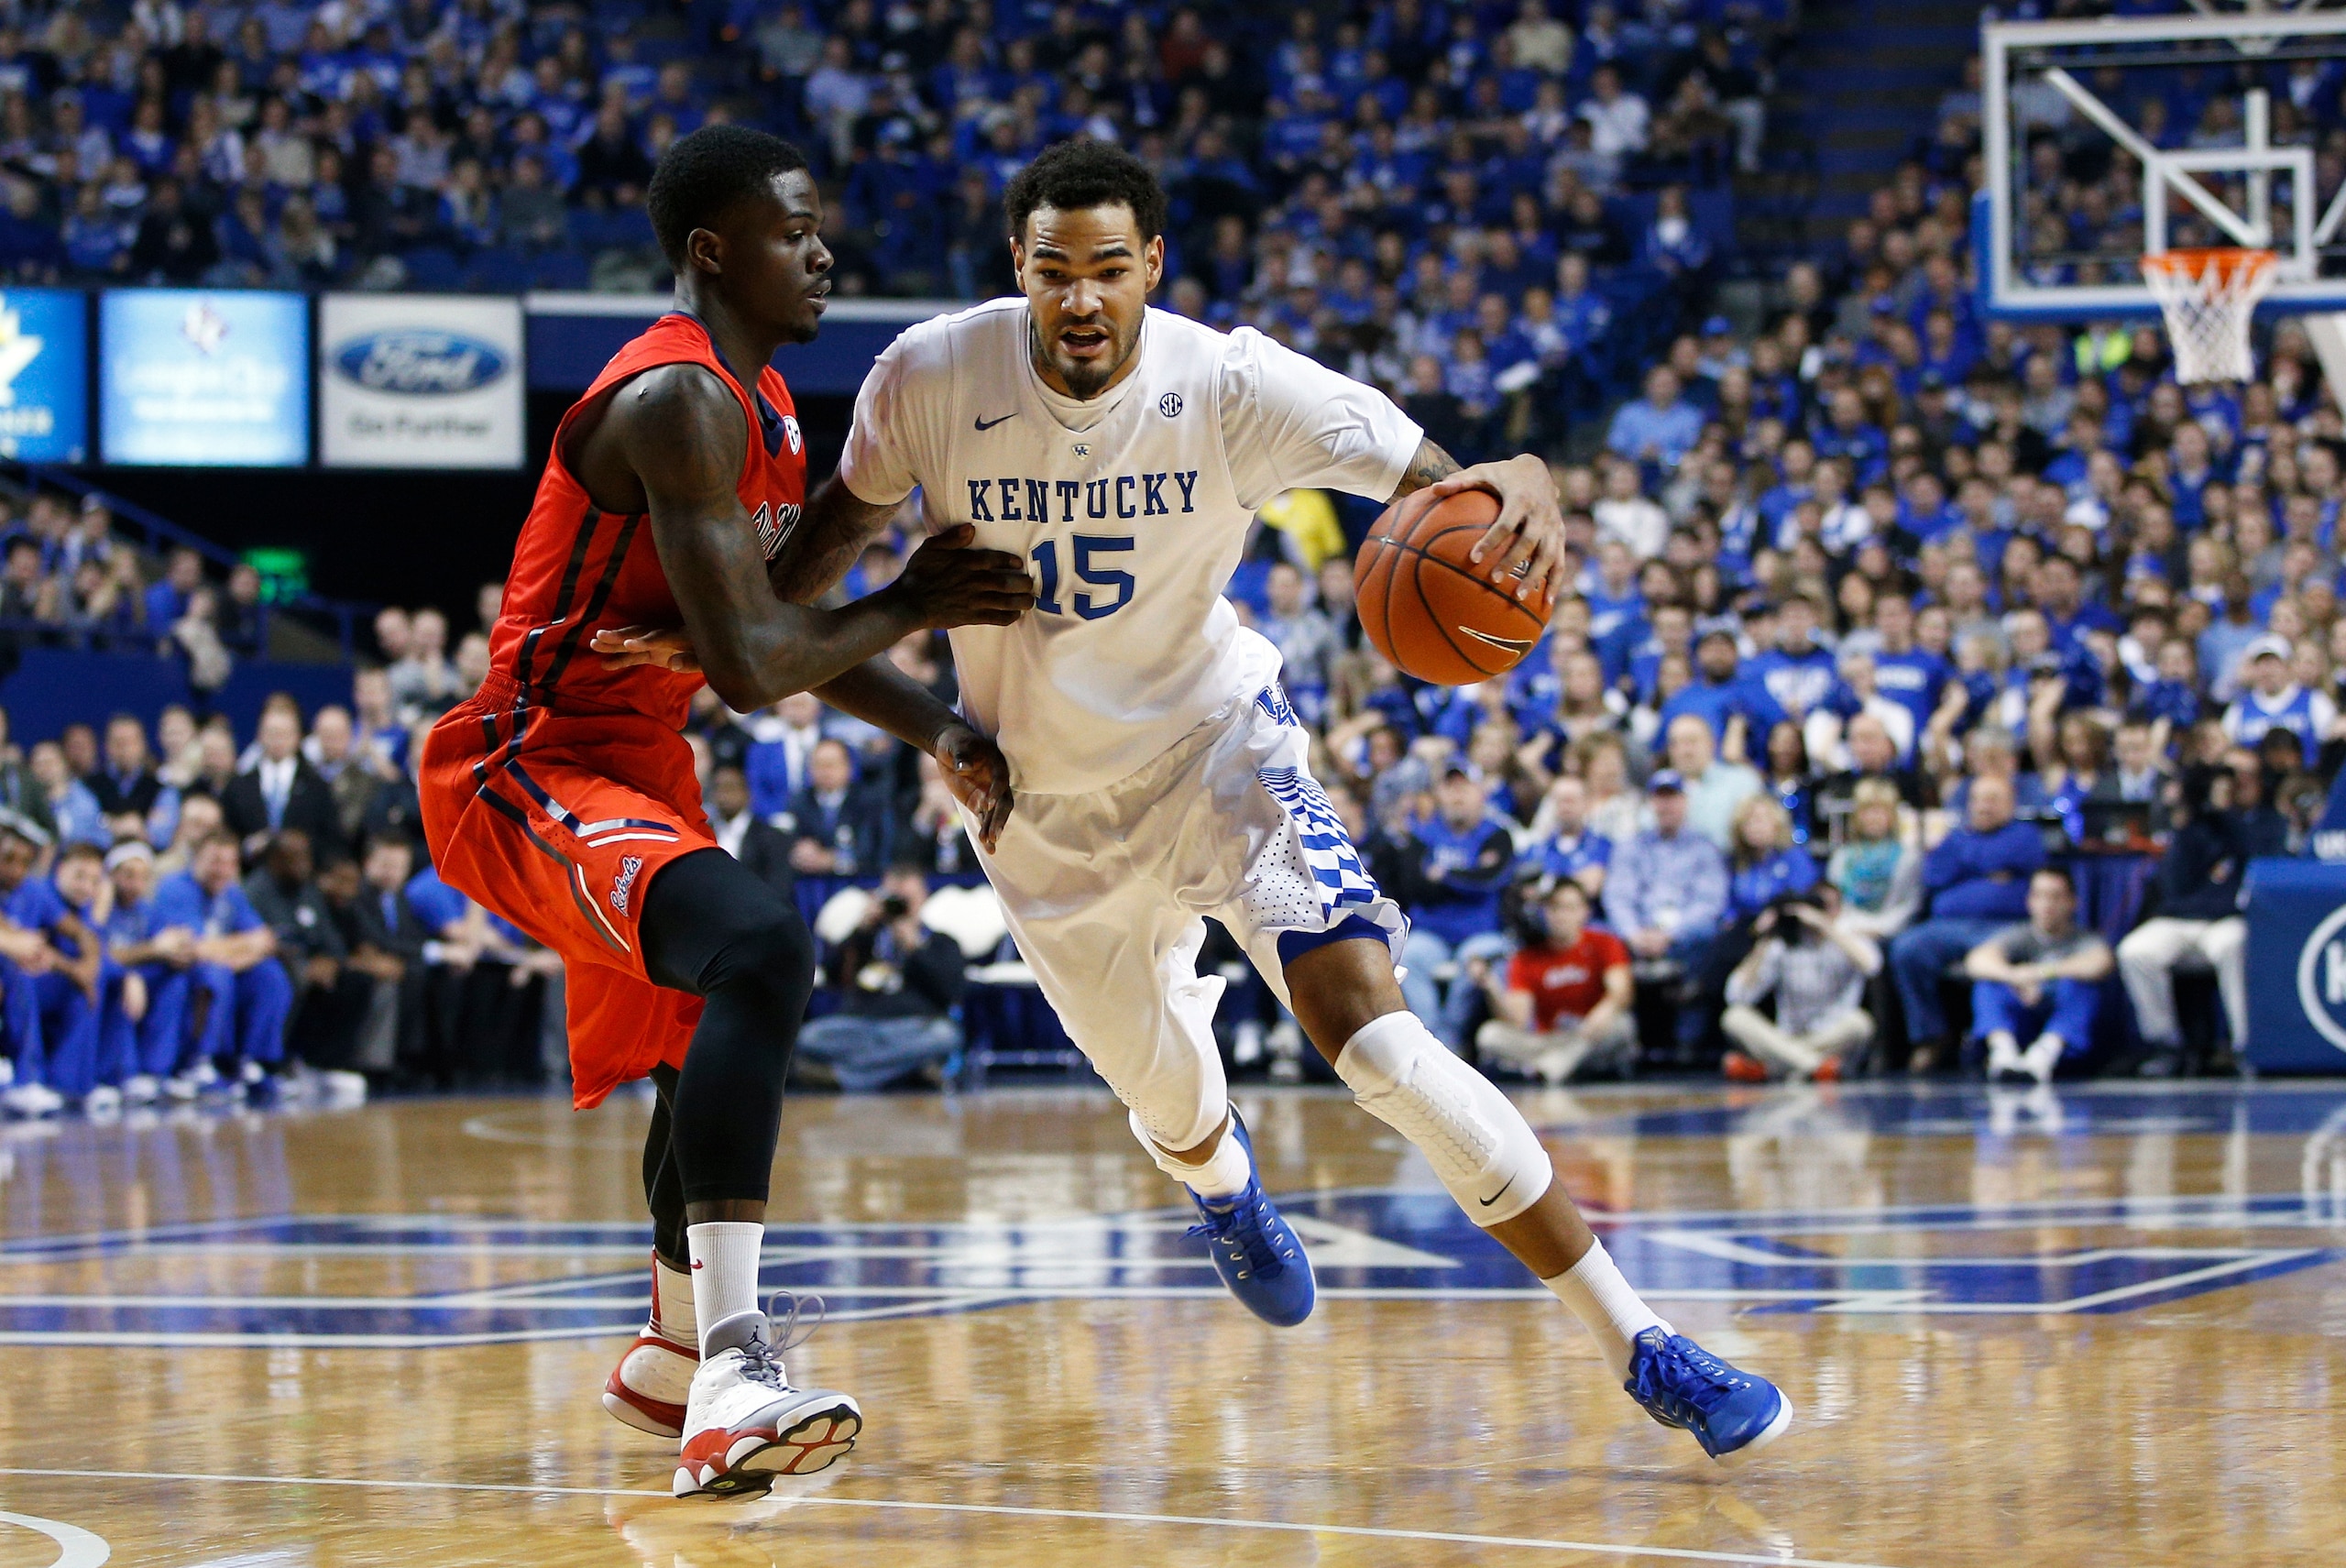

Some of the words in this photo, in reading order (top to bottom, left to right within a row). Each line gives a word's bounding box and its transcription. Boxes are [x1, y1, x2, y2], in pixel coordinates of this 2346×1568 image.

[360, 335, 481, 391] Ford
[1160, 393, 1182, 417] SEC
[968, 470, 1198, 523] KENTUCKY
[1028, 532, 1135, 620] 15
[609, 857, 642, 917] Rebels
